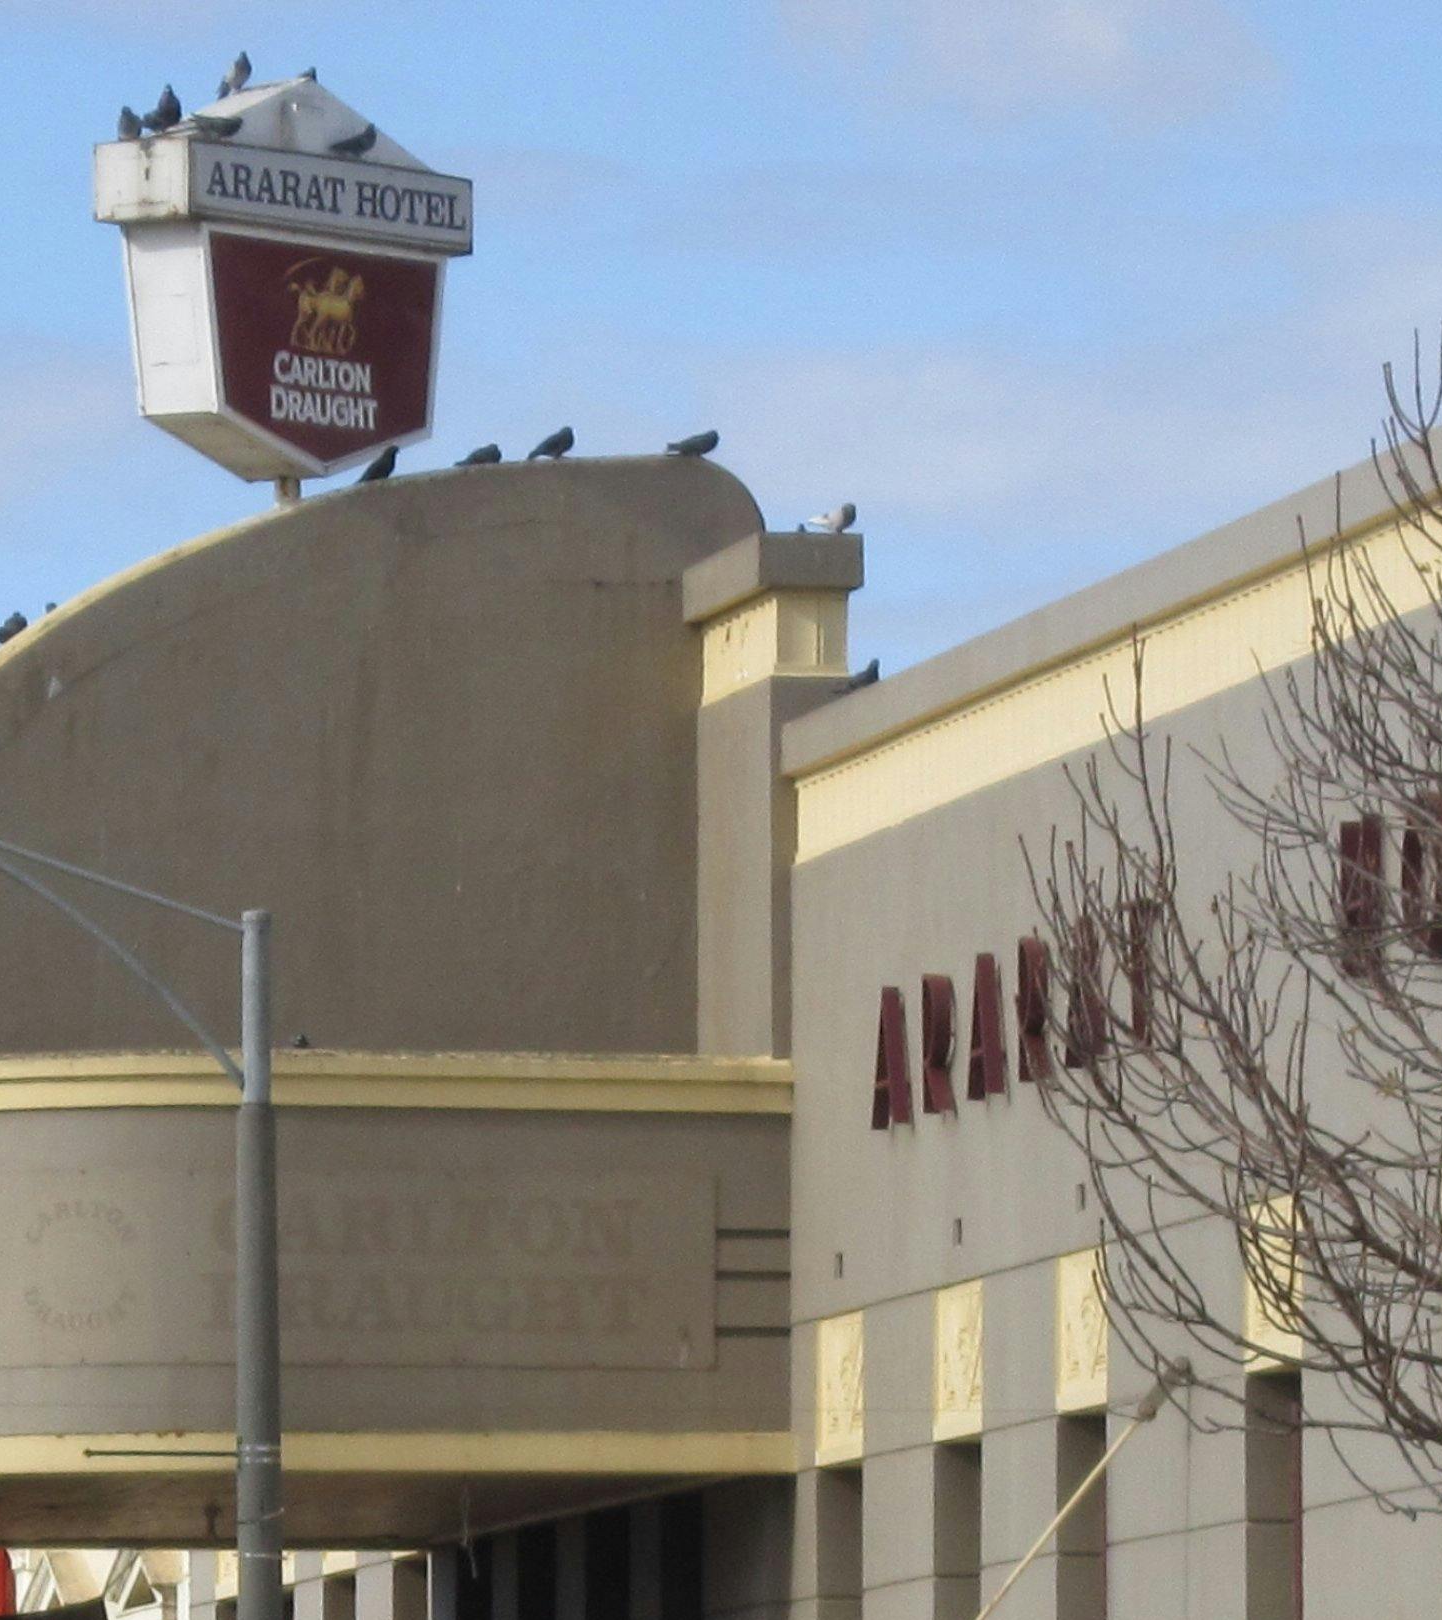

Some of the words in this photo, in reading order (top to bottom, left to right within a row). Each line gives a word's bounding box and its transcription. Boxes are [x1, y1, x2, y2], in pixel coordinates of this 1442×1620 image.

[206, 160, 346, 216] ARARAT
[356, 179, 466, 232] HOTEL
[273, 350, 372, 394] CARLTON
[270, 383, 378, 431] DRAUGHT
[870, 896, 1163, 1131] ARARAT
